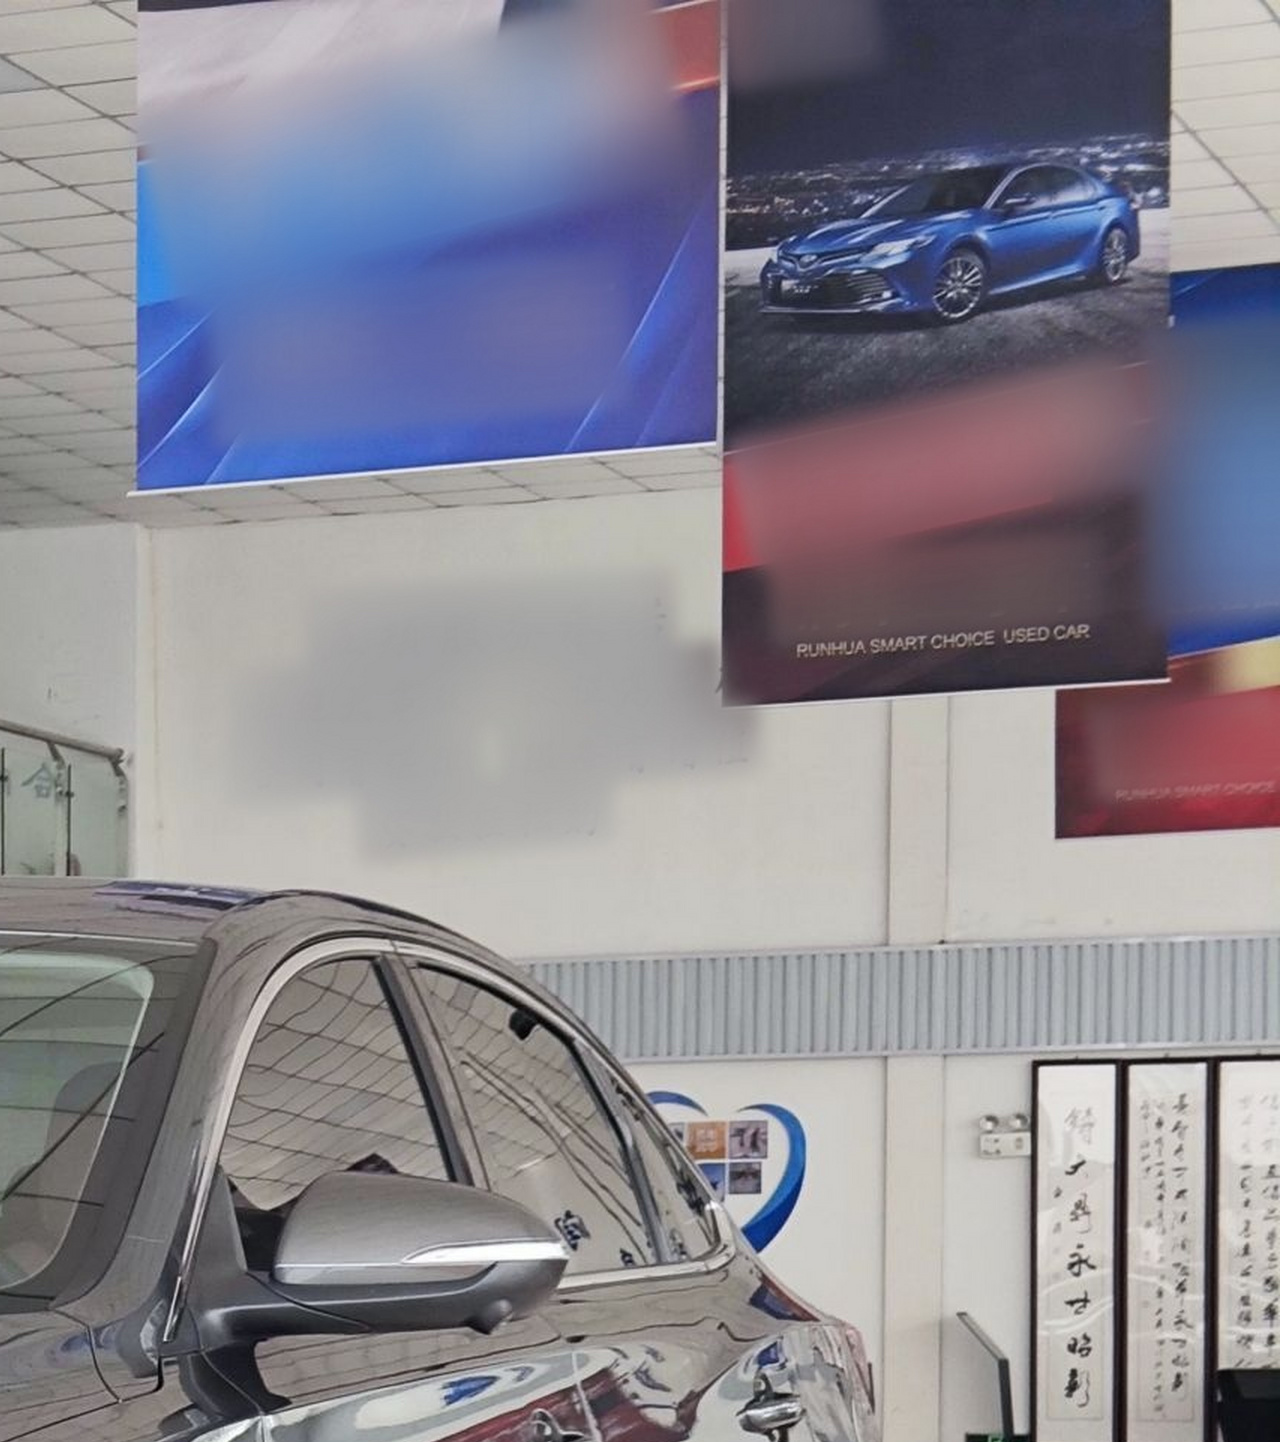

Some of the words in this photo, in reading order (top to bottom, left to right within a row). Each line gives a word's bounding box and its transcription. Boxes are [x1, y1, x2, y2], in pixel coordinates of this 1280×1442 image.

[796, 640, 867, 658] RUNHUA
[869, 634, 928, 653] SMART
[930, 629, 996, 650] CHOICE
[1003, 625, 1050, 645] USED
[1053, 623, 1091, 641] CAR
